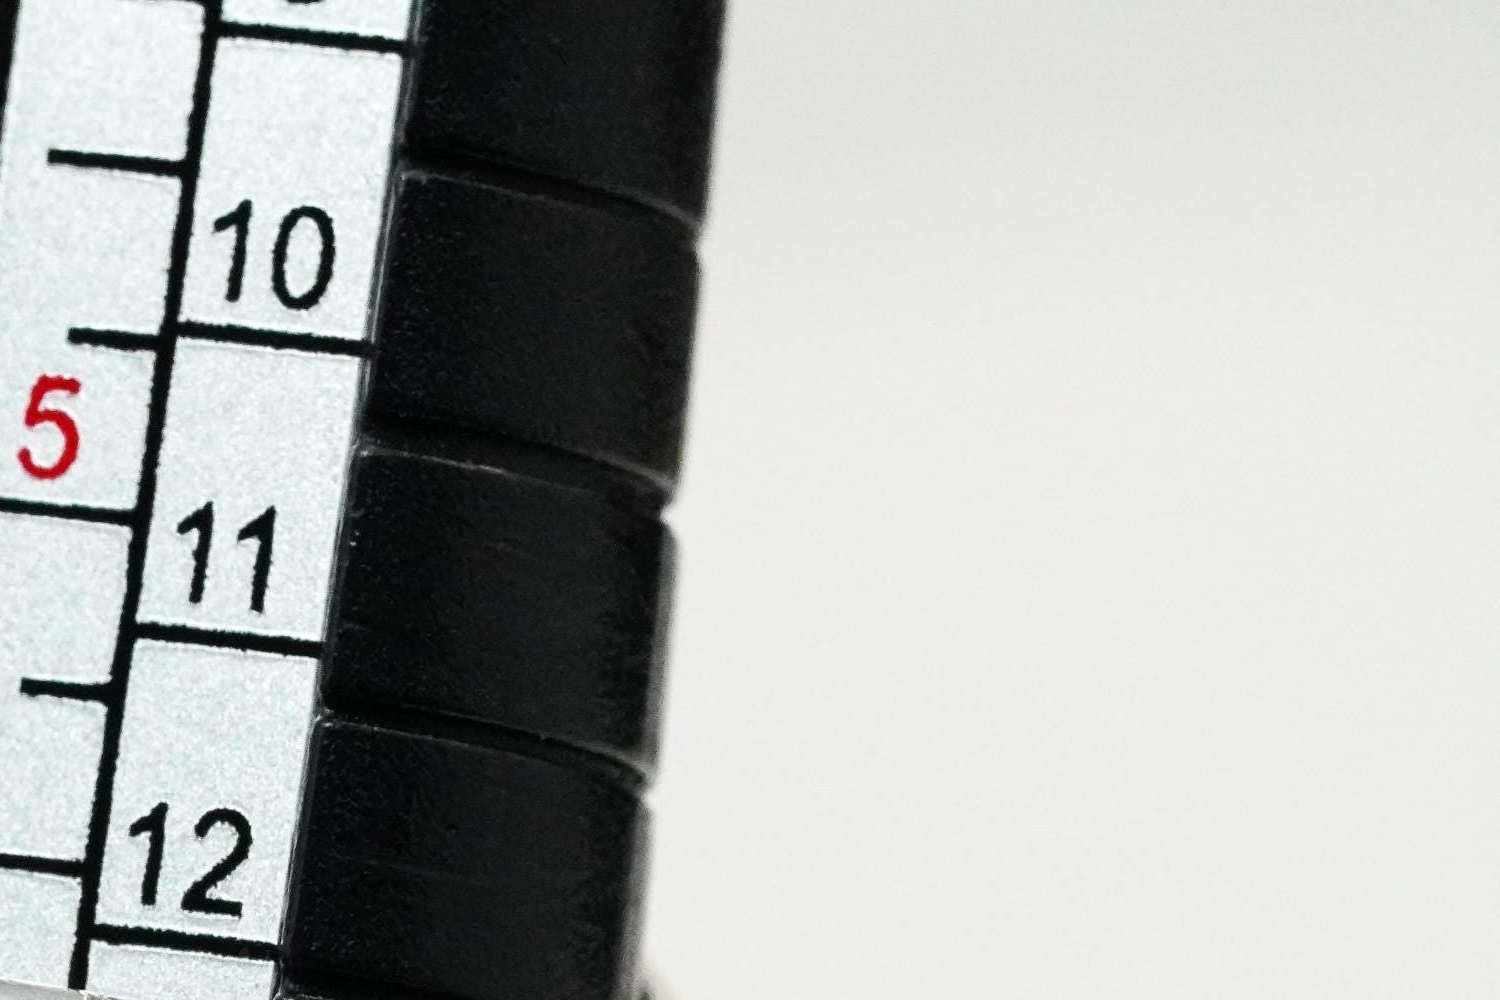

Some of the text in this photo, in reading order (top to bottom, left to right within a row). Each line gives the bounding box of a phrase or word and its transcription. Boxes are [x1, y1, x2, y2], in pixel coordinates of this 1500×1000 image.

[214, 200, 336, 311] 10
[18, 375, 81, 480] 5
[177, 502, 277, 613] 11
[129, 803, 253, 918] 12
